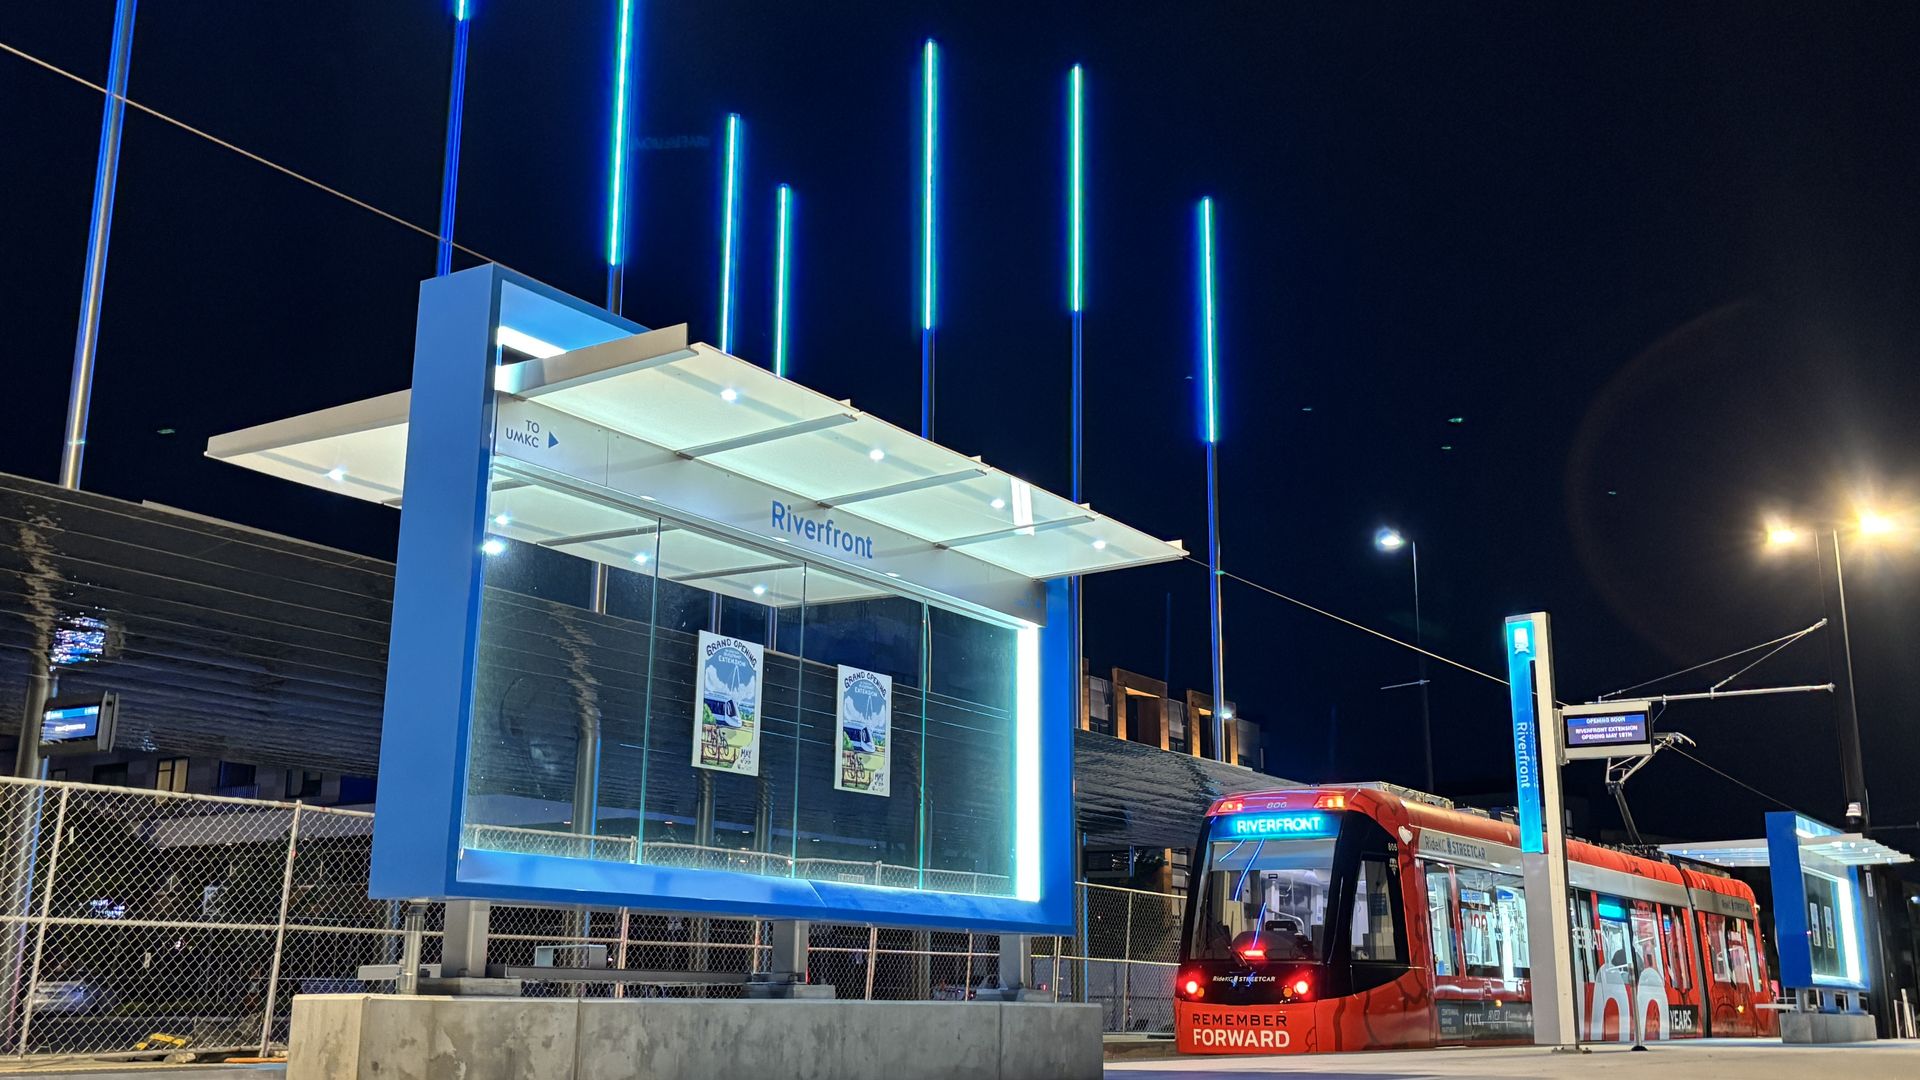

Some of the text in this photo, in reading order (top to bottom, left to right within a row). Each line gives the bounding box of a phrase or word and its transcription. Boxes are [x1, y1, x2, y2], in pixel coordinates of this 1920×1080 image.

[526, 420, 540, 434] TO
[506, 427, 540, 448] UMKC
[772, 500, 873, 559] Riverfront
[706, 638, 731, 656] GRAND
[733, 640, 757, 668] OPENING
[844, 671, 887, 698] GRAND OPENING
[1586, 716, 1609, 724] OPENING
[1608, 725, 1638, 733] EXTENSION
[1517, 721, 1531, 788] Riverfront
[1236, 816, 1322, 833] RIVERFRONT
[1452, 841, 1486, 859] STREETCAR
[1192, 1013, 1288, 1027] REMEMBER
[1670, 1009, 1692, 1030] YEARS
[1193, 1028, 1291, 1048] FORWARD
